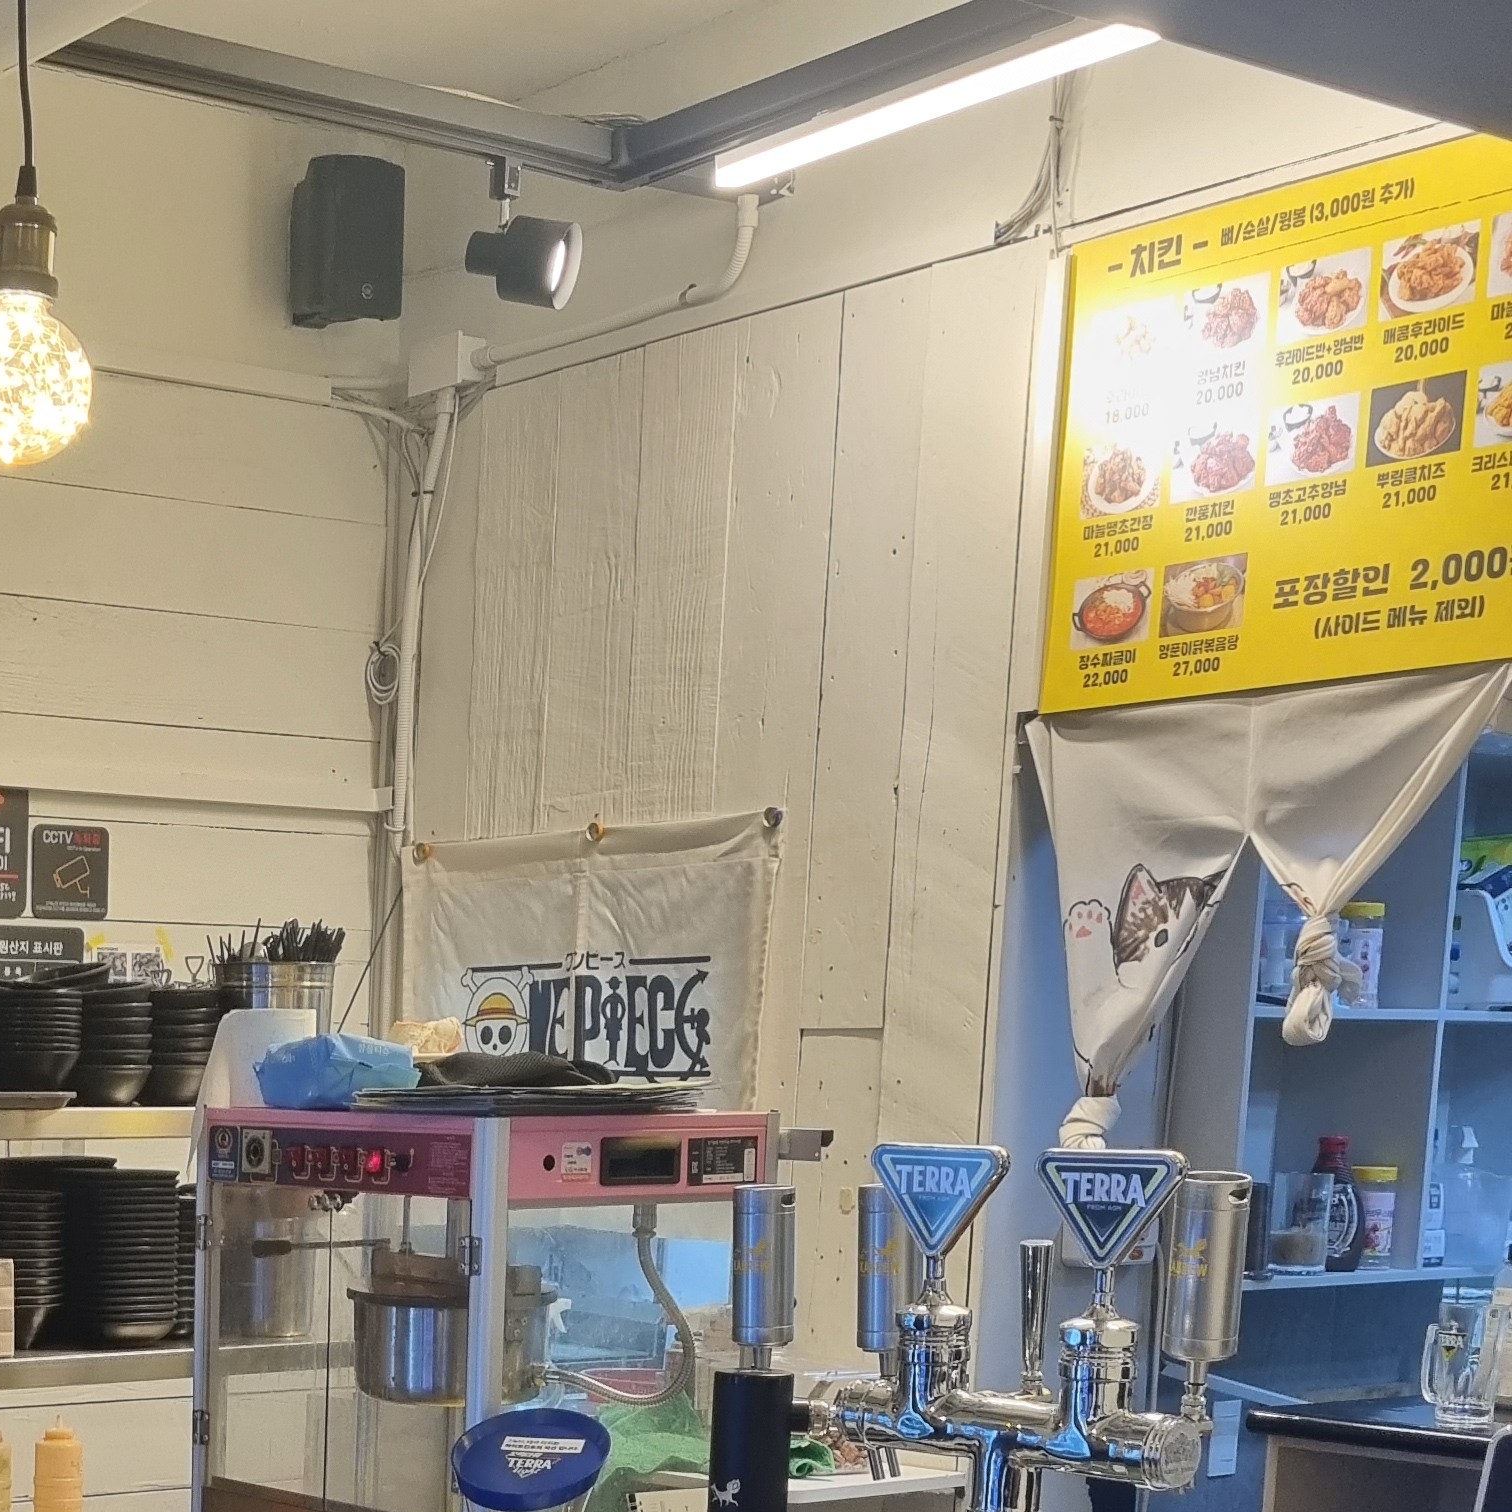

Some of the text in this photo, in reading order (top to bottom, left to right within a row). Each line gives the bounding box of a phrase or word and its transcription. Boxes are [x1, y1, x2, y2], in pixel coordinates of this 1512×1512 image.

[1130, 177, 1414, 278] 치킨 뼈/순살/윙봉 (3,000원 추가)
[1383, 312, 1465, 345] 매콤후라이드
[1275, 333, 1364, 368] 후라이드반+양념반
[1394, 337, 1449, 363] 20,000
[1197, 361, 1246, 385] 양념치킨
[1292, 359, 1343, 385] 20,000
[1268, 478, 1347, 509] 땡초고추양념
[1382, 484, 1437, 509] 21,000
[1185, 499, 1235, 523] 깐풍치킨
[1280, 502, 1332, 526] 21,000
[1083, 514, 1153, 541] 마늘땡초간장
[1184, 520, 1233, 542] 21,000
[1094, 536, 1139, 558] 21,000
[1273, 546, 1512, 610] 포장할인 2,000
[1314, 595, 1485, 639] (사이드 메뉴 제외)
[1078, 648, 1136, 671] 장수짜글이
[1172, 656, 1220, 677] 27,000
[1083, 668, 1128, 688] 22,000
[43, 830, 73, 845] CCTV
[0, 940, 30, 955] 원산지
[33, 942, 64, 956] 표시판
[565, 952, 625, 971] ワンピース
[896, 1164, 972, 1199] TERRA
[1060, 1172, 1146, 1208] TERRA
[508, 1458, 552, 1470] TERRA
